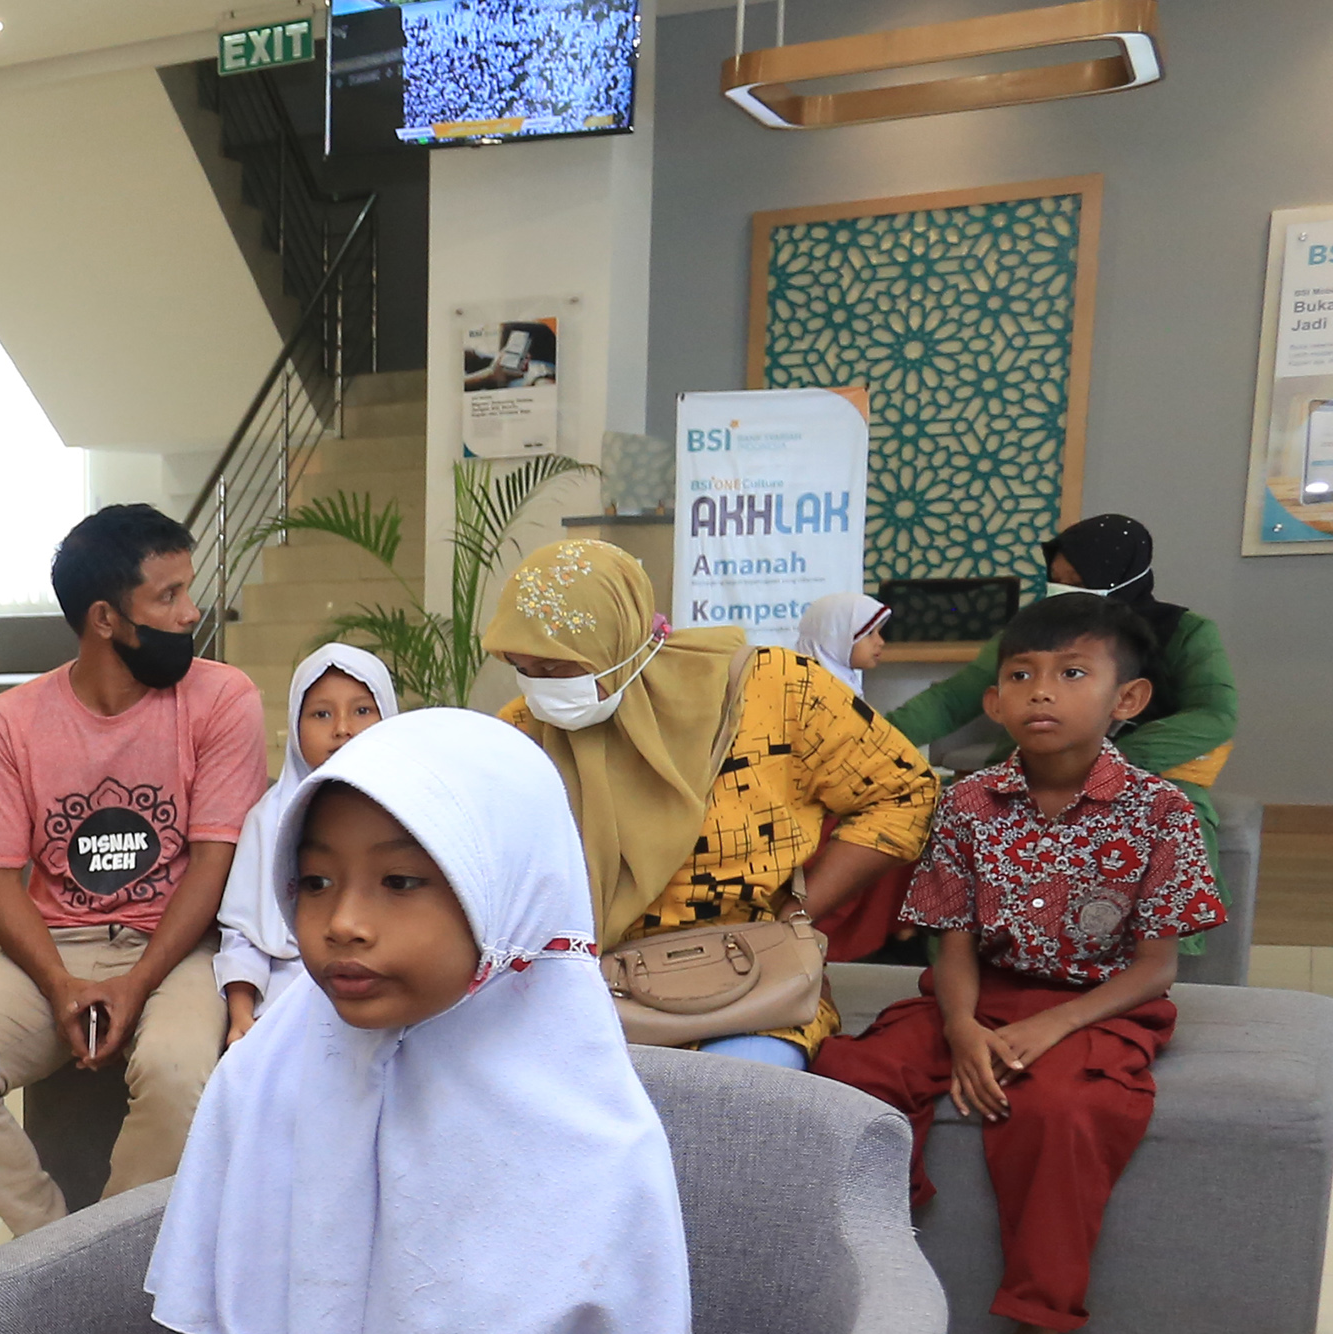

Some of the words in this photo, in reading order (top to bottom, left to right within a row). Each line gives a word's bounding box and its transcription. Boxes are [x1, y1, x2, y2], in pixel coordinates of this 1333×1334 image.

[223, 22, 309, 71] EXIT
[1291, 317, 1327, 332] Jadi
[687, 428, 731, 452] BSI
[743, 478, 784, 490] Culture
[691, 491, 850, 537] AKHLAK
[692, 550, 807, 576] Amanah
[77, 832, 149, 855] DISNAK
[89, 852, 137, 873] ACEH
